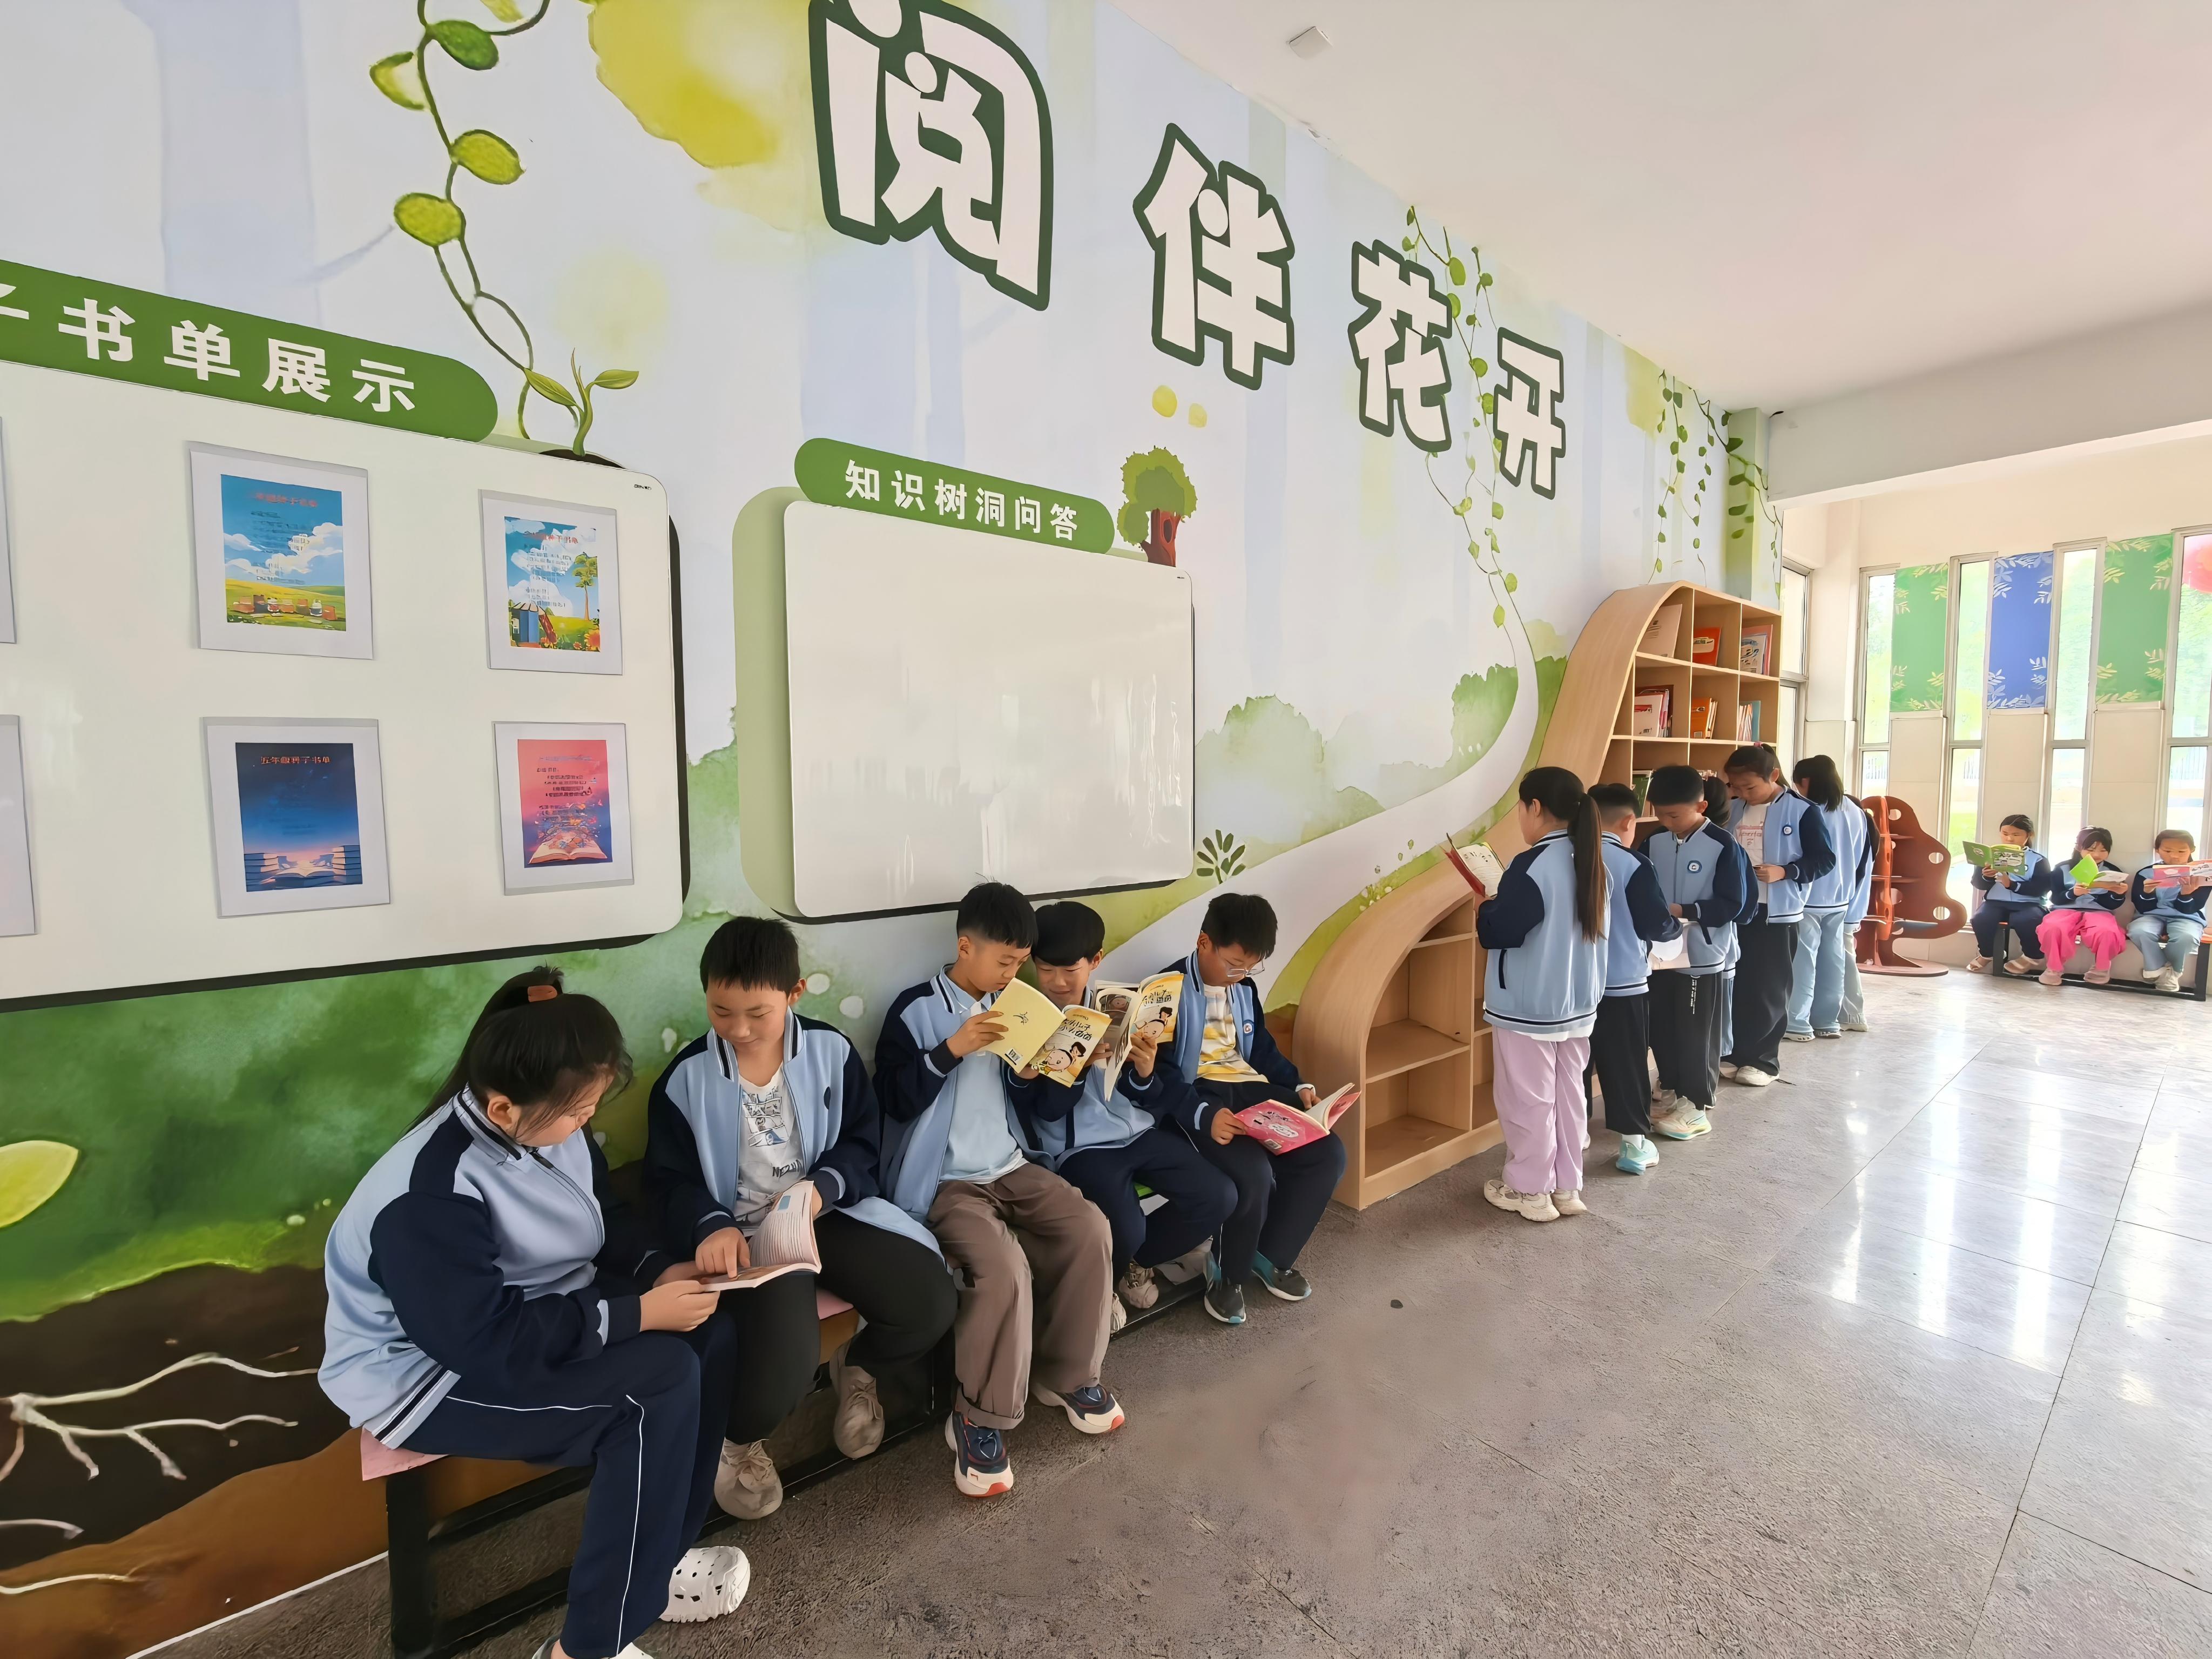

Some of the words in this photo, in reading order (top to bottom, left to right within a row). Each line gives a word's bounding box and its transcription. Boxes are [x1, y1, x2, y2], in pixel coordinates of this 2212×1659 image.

[809, 0, 1566, 498] 阅伴花开
[845, 459, 1078, 541] 知识树洞问答
